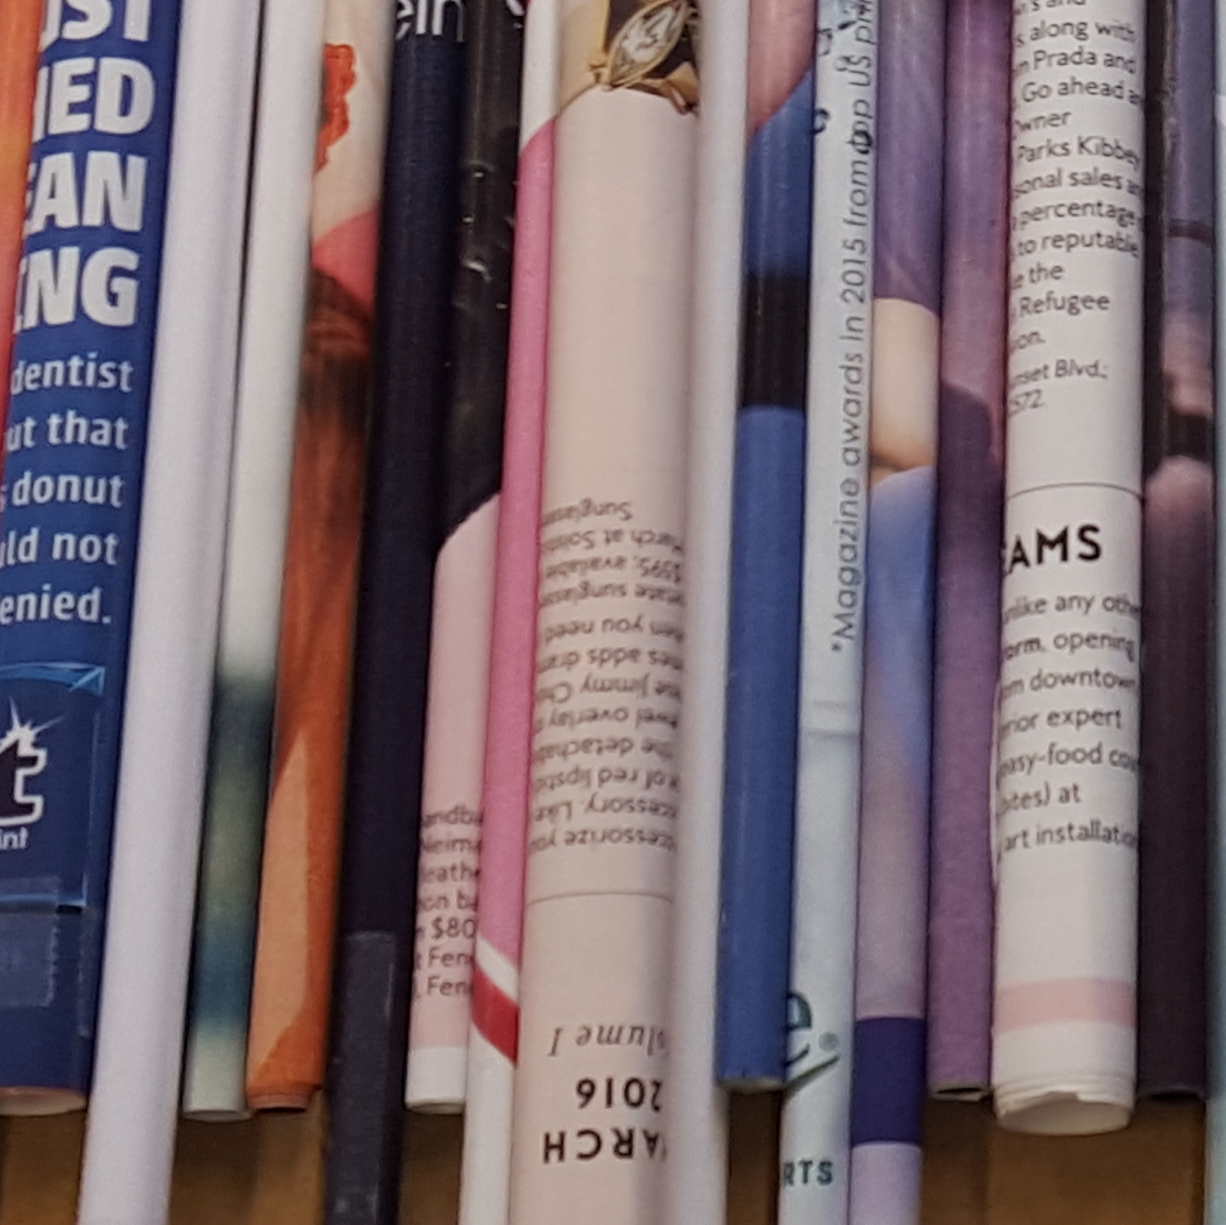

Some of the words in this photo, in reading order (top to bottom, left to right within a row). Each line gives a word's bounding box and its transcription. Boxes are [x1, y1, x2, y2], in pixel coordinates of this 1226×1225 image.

[1031, 20, 1089, 41] along
[846, 55, 872, 87] US
[1034, 49, 1097, 70] Prada
[1022, 81, 1050, 102] Go
[1058, 76, 1123, 100] ahead
[1070, 164, 1122, 189] sales
[22, 150, 149, 241] AN
[843, 160, 868, 227] from
[840, 236, 867, 304] 2015
[1029, 262, 1063, 281] the
[1019, 291, 1110, 316] Refugee
[839, 317, 864, 341] in
[838, 353, 863, 466] awards
[47, 409, 130, 450] that
[12, 472, 126, 510] donut
[53, 532, 120, 566] not
[604, 529, 623, 547] at
[1009, 524, 1102, 575] AMS
[1055, 595, 1095, 615] any
[601, 614, 643, 635] you
[586, 647, 641, 668] adds
[580, 674, 650, 697] Jimmy
[1047, 707, 1122, 732] expert
[598, 767, 637, 788] red
[1058, 783, 1081, 803] at
[576, 1078, 663, 1113] 2016
[542, 1127, 666, 1165] ARCH
